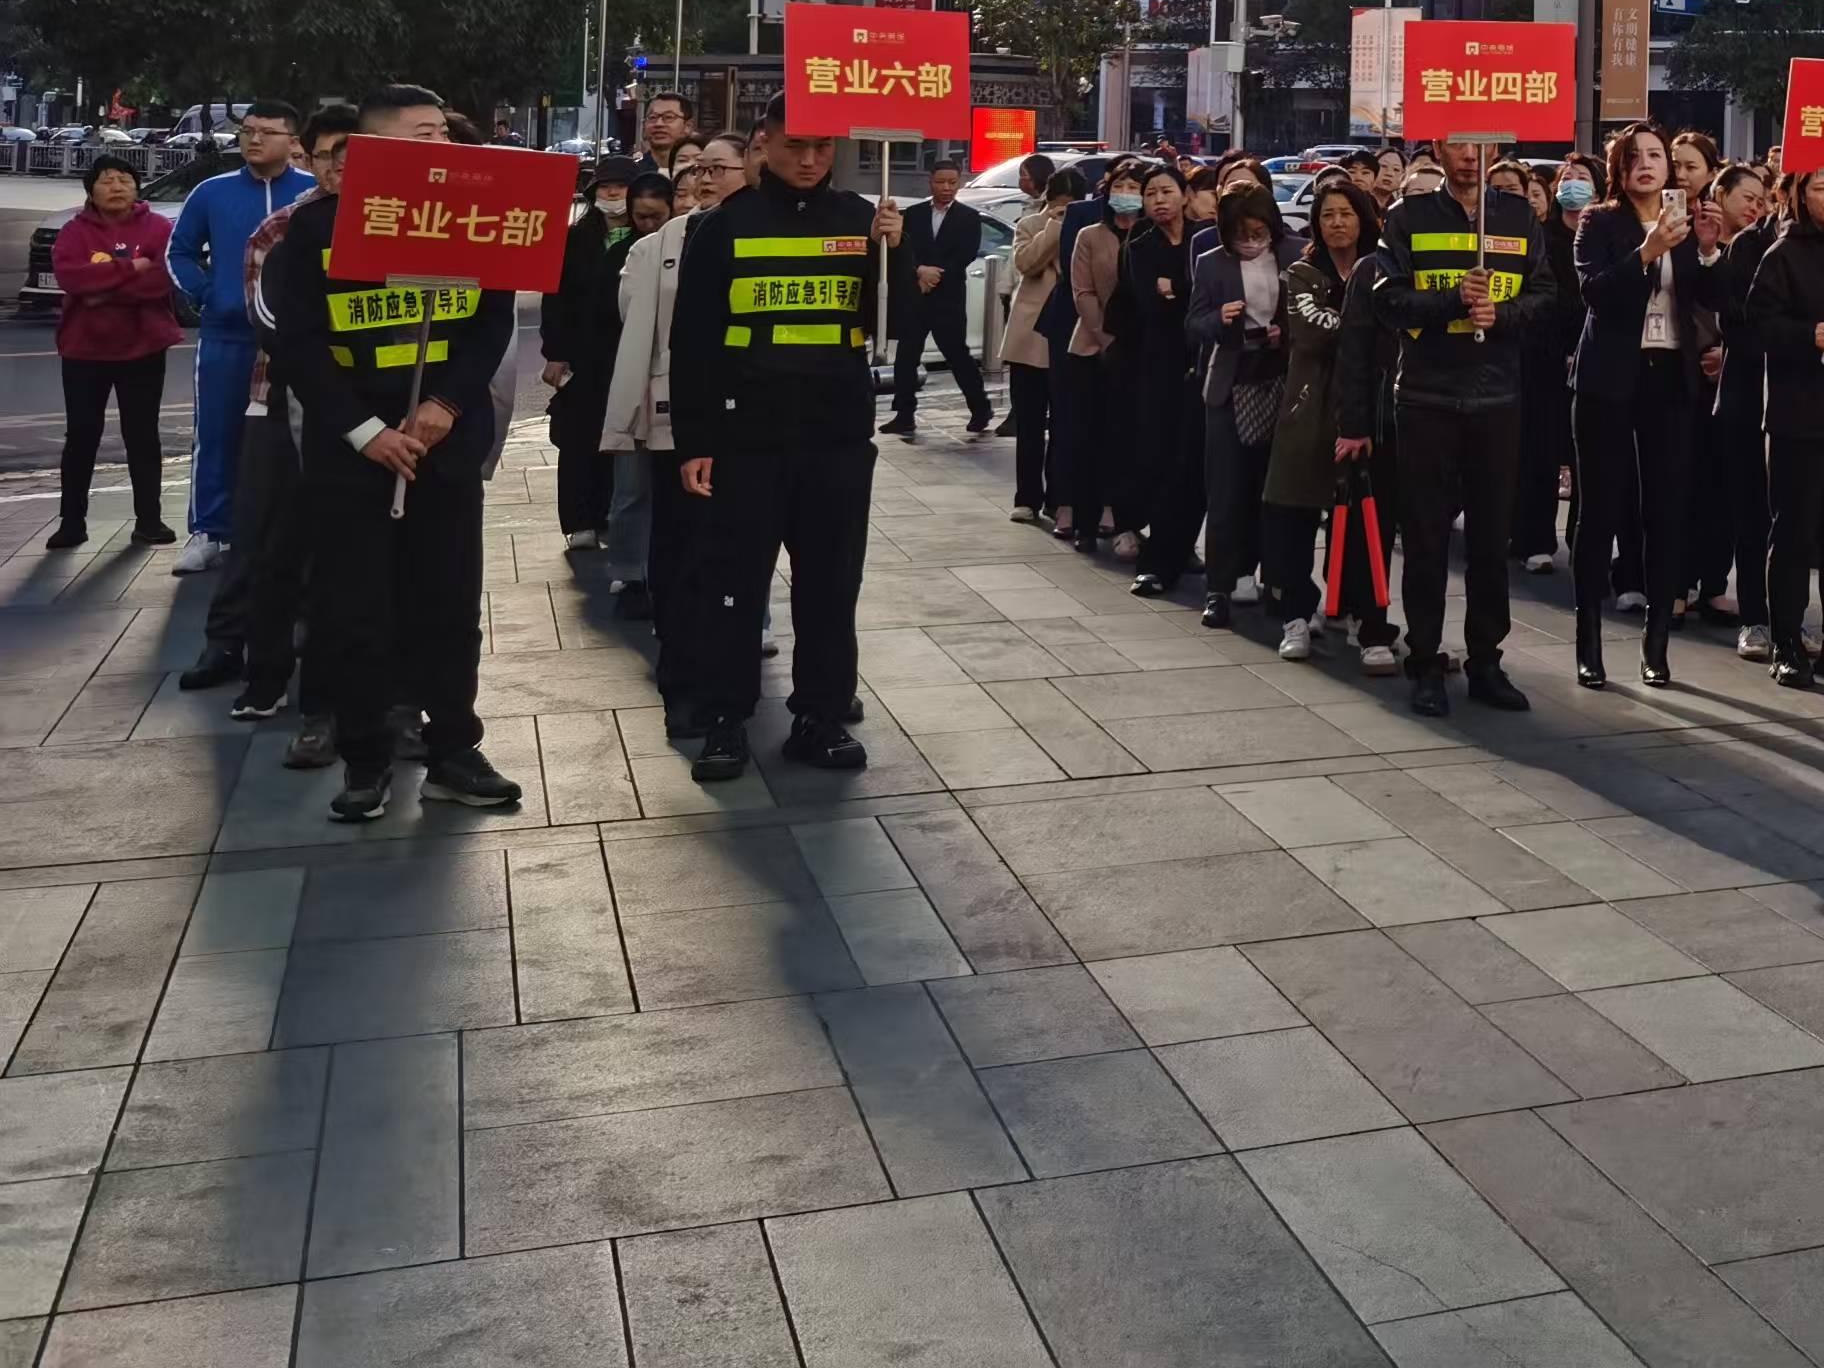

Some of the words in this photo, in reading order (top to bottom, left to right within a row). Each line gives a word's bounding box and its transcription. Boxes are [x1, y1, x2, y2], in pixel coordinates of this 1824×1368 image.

[804, 56, 952, 98] 营业六部
[1420, 69, 1558, 104] 营业四部
[362, 194, 548, 247] 营业七部
